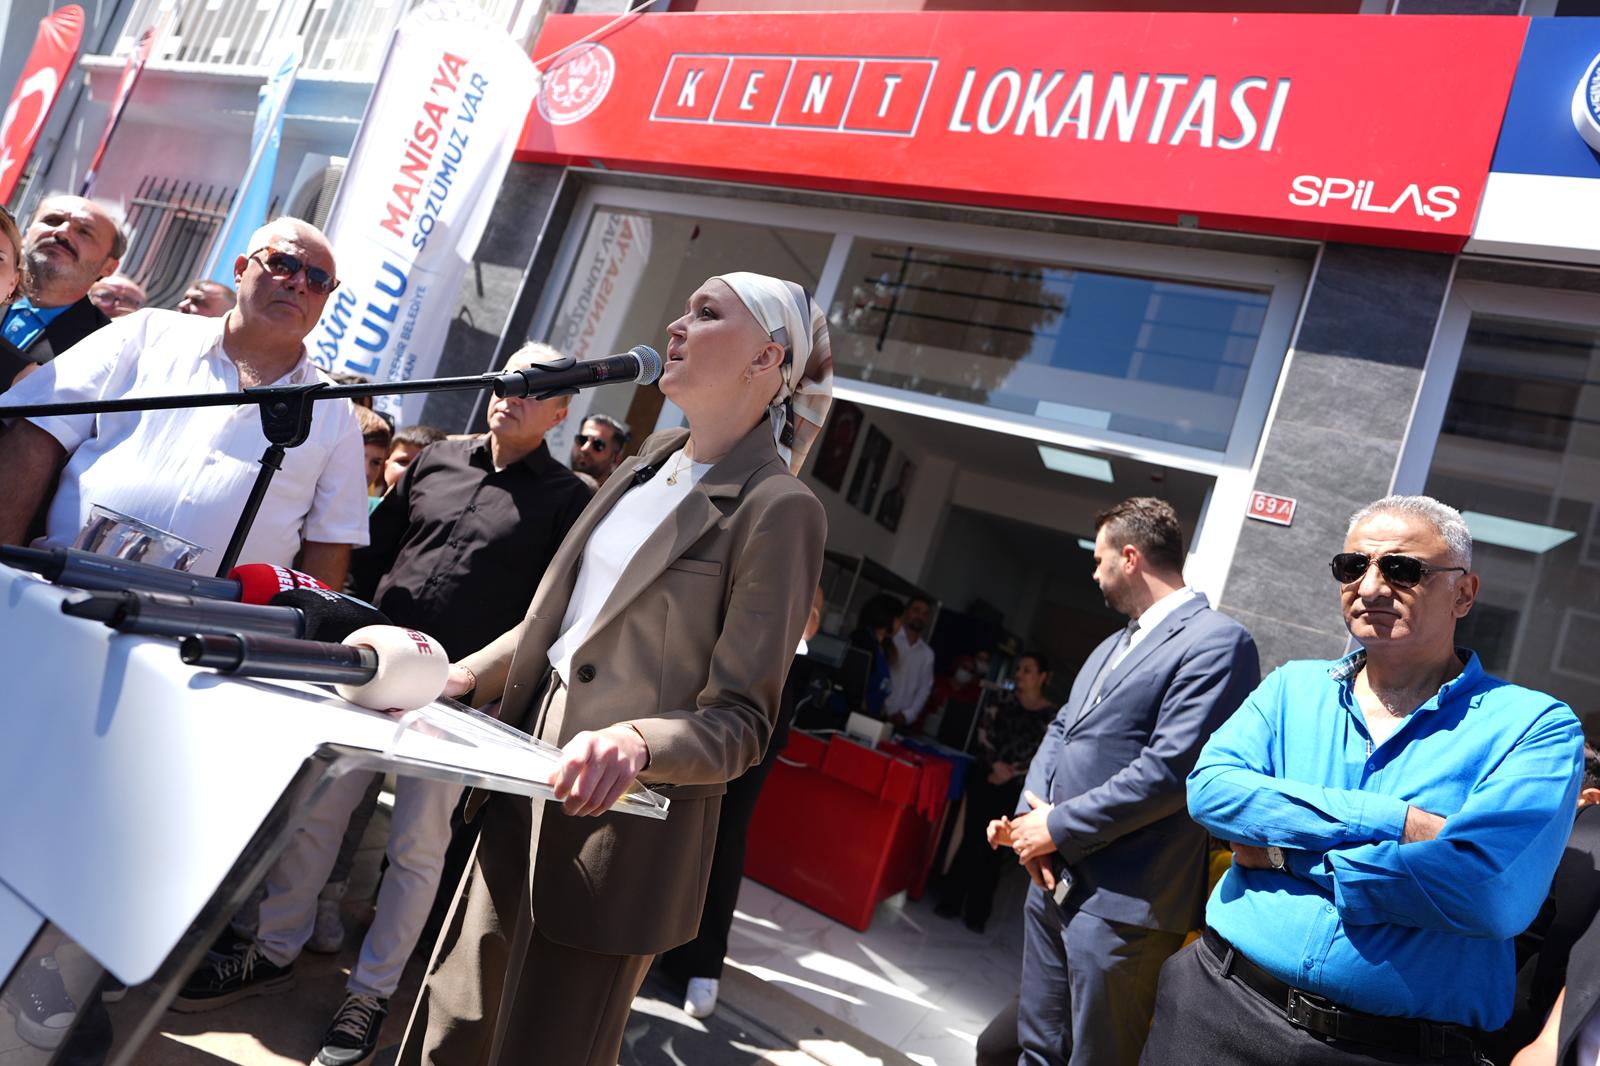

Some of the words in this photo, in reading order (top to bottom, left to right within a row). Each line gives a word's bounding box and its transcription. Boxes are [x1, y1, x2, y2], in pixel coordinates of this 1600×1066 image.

[379, 51, 469, 239] MANİSA'YA
[457, 72, 489, 124] VAR
[676, 68, 902, 118] KENT
[948, 67, 1291, 152] LOKANTASI
[344, 260, 408, 376] LULU
